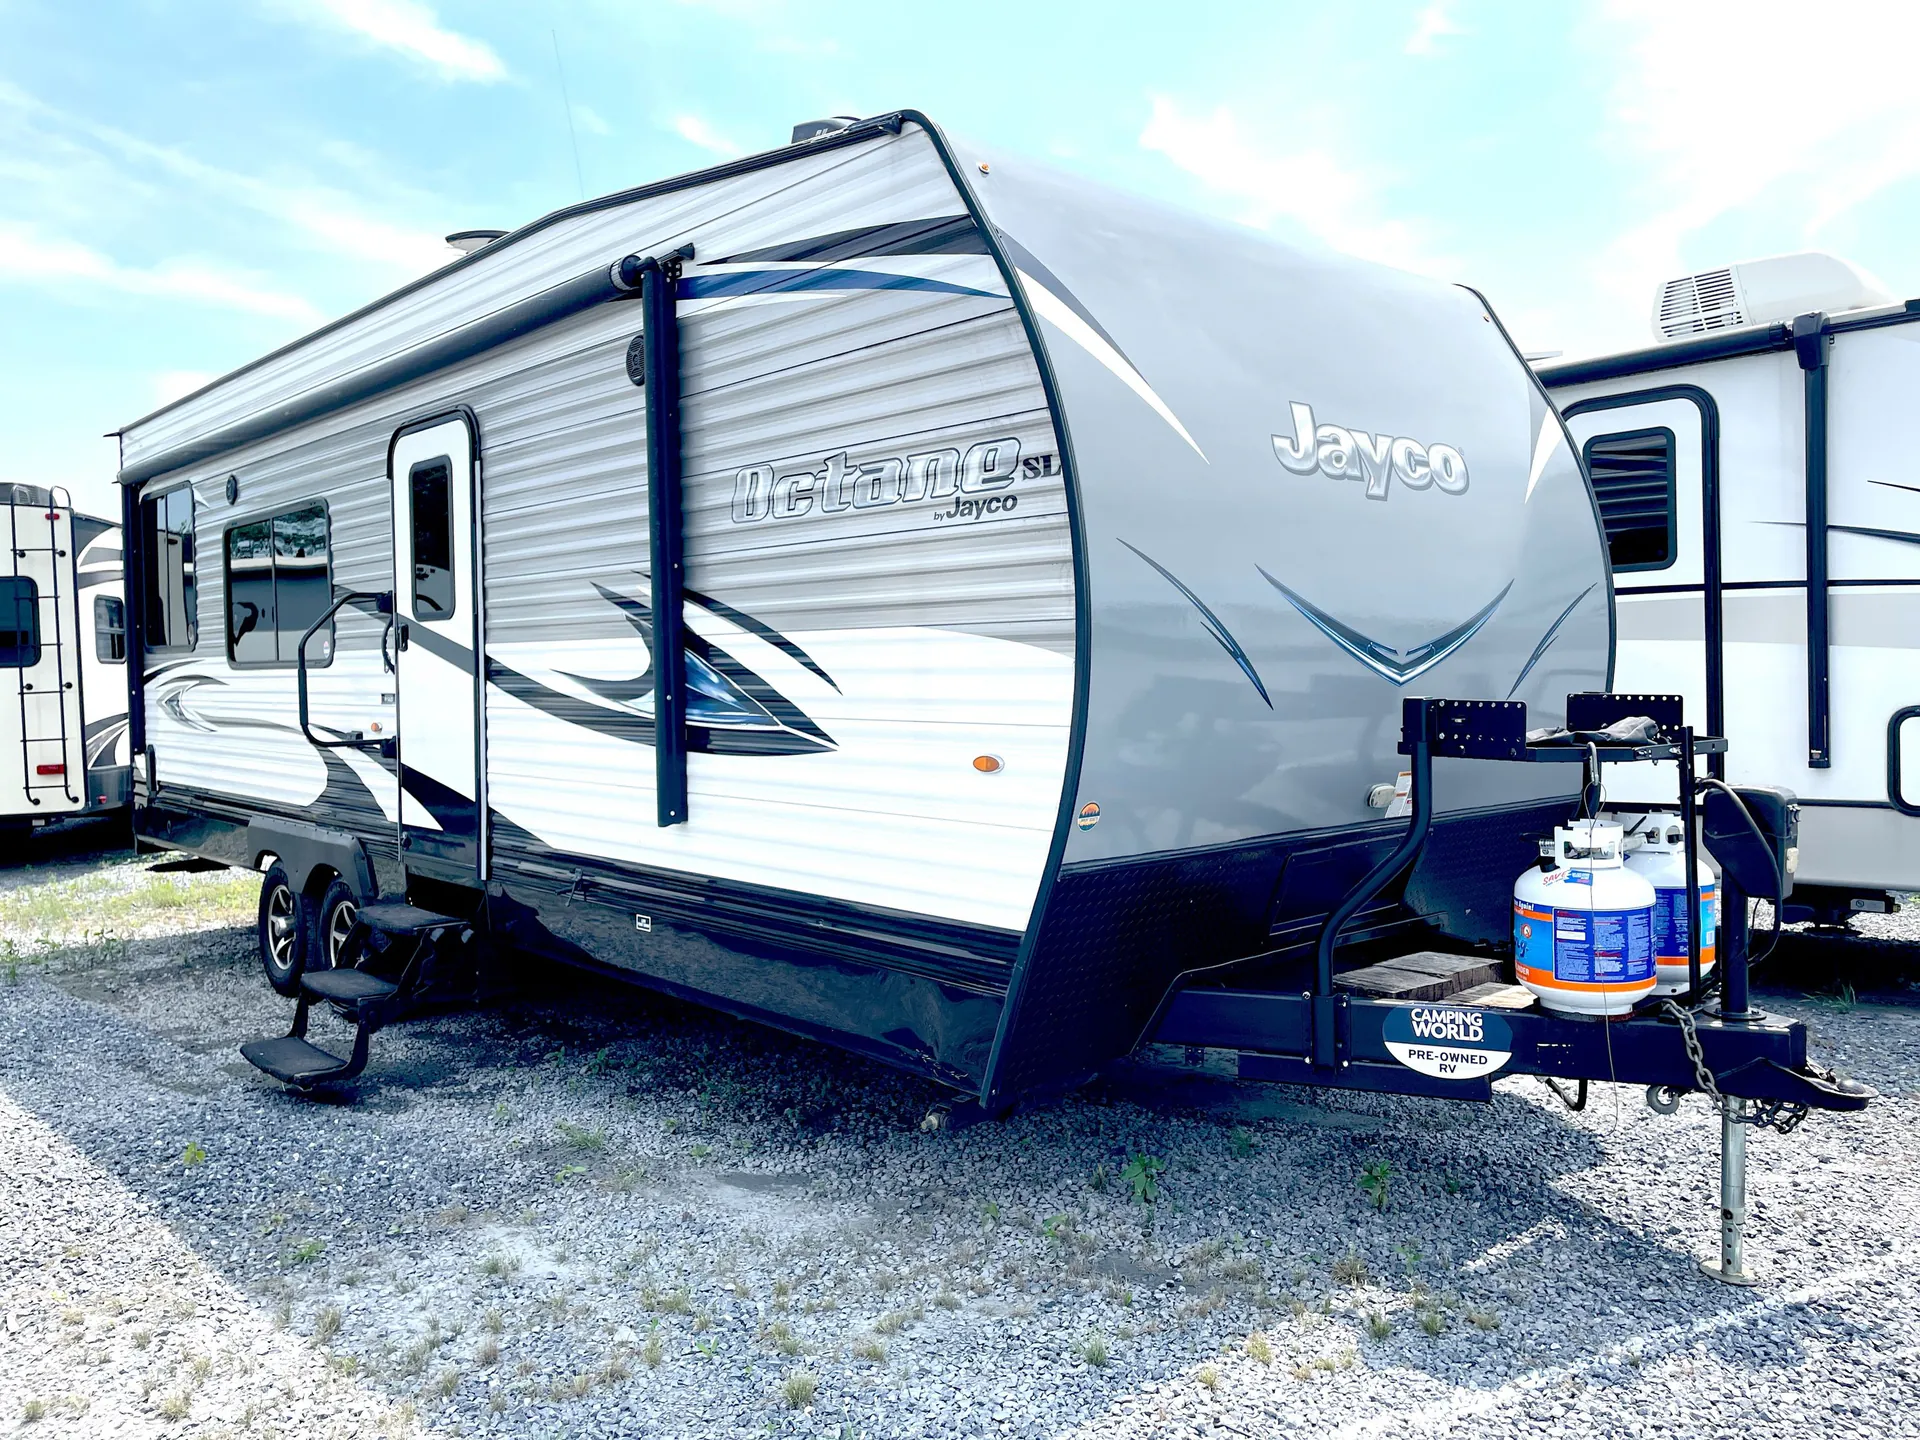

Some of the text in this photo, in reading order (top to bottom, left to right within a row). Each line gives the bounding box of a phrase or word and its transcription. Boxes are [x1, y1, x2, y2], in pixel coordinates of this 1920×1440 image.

[1270, 400, 1470, 502] Jayco
[731, 437, 1021, 524] Octane
[933, 494, 1018, 522] by Jayco
[1410, 1008, 1483, 1027] CAMPING
[1408, 1049, 1488, 1066] PRE-OWNED
[1439, 1063, 1457, 1074] RV
